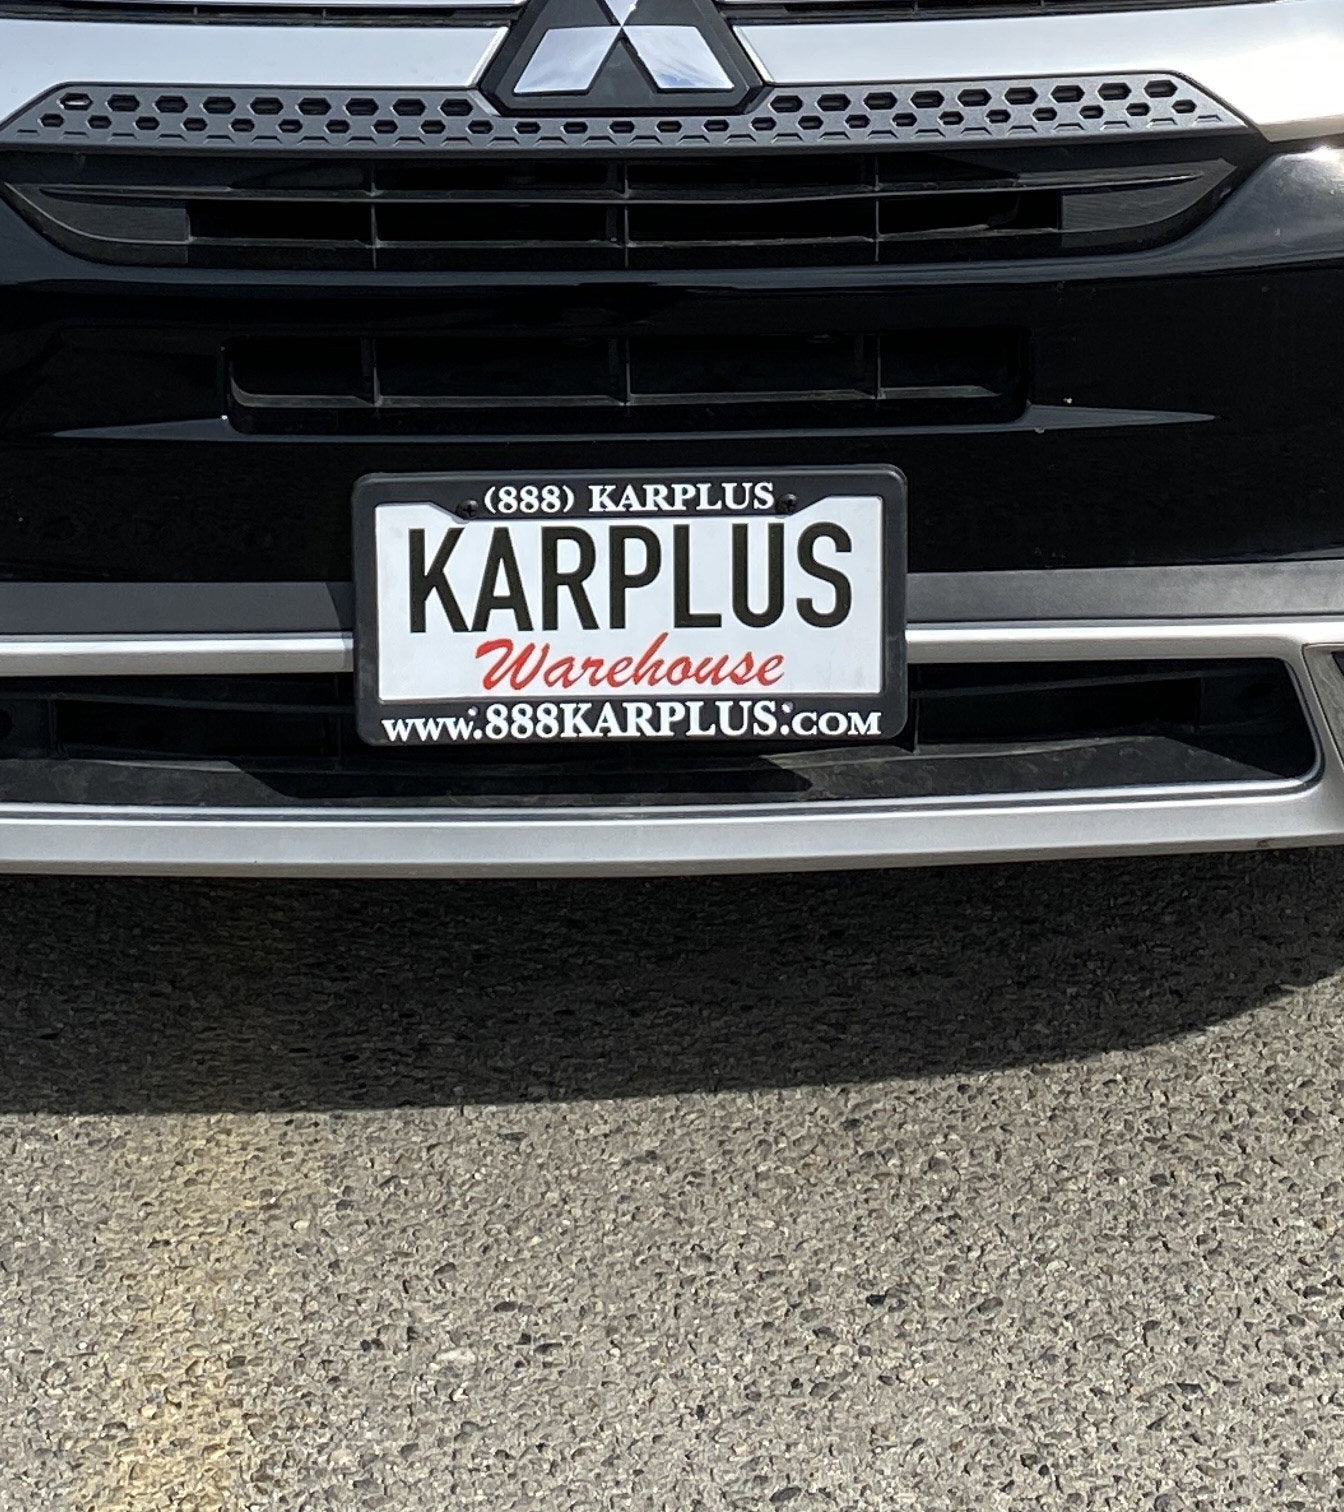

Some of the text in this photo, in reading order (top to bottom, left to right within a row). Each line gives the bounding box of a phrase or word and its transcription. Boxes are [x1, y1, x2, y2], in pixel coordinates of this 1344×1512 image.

[483, 482, 775, 514] (888) KARPLUS
[408, 521, 853, 633] KARPLUS
[475, 632, 784, 691] Warehouse
